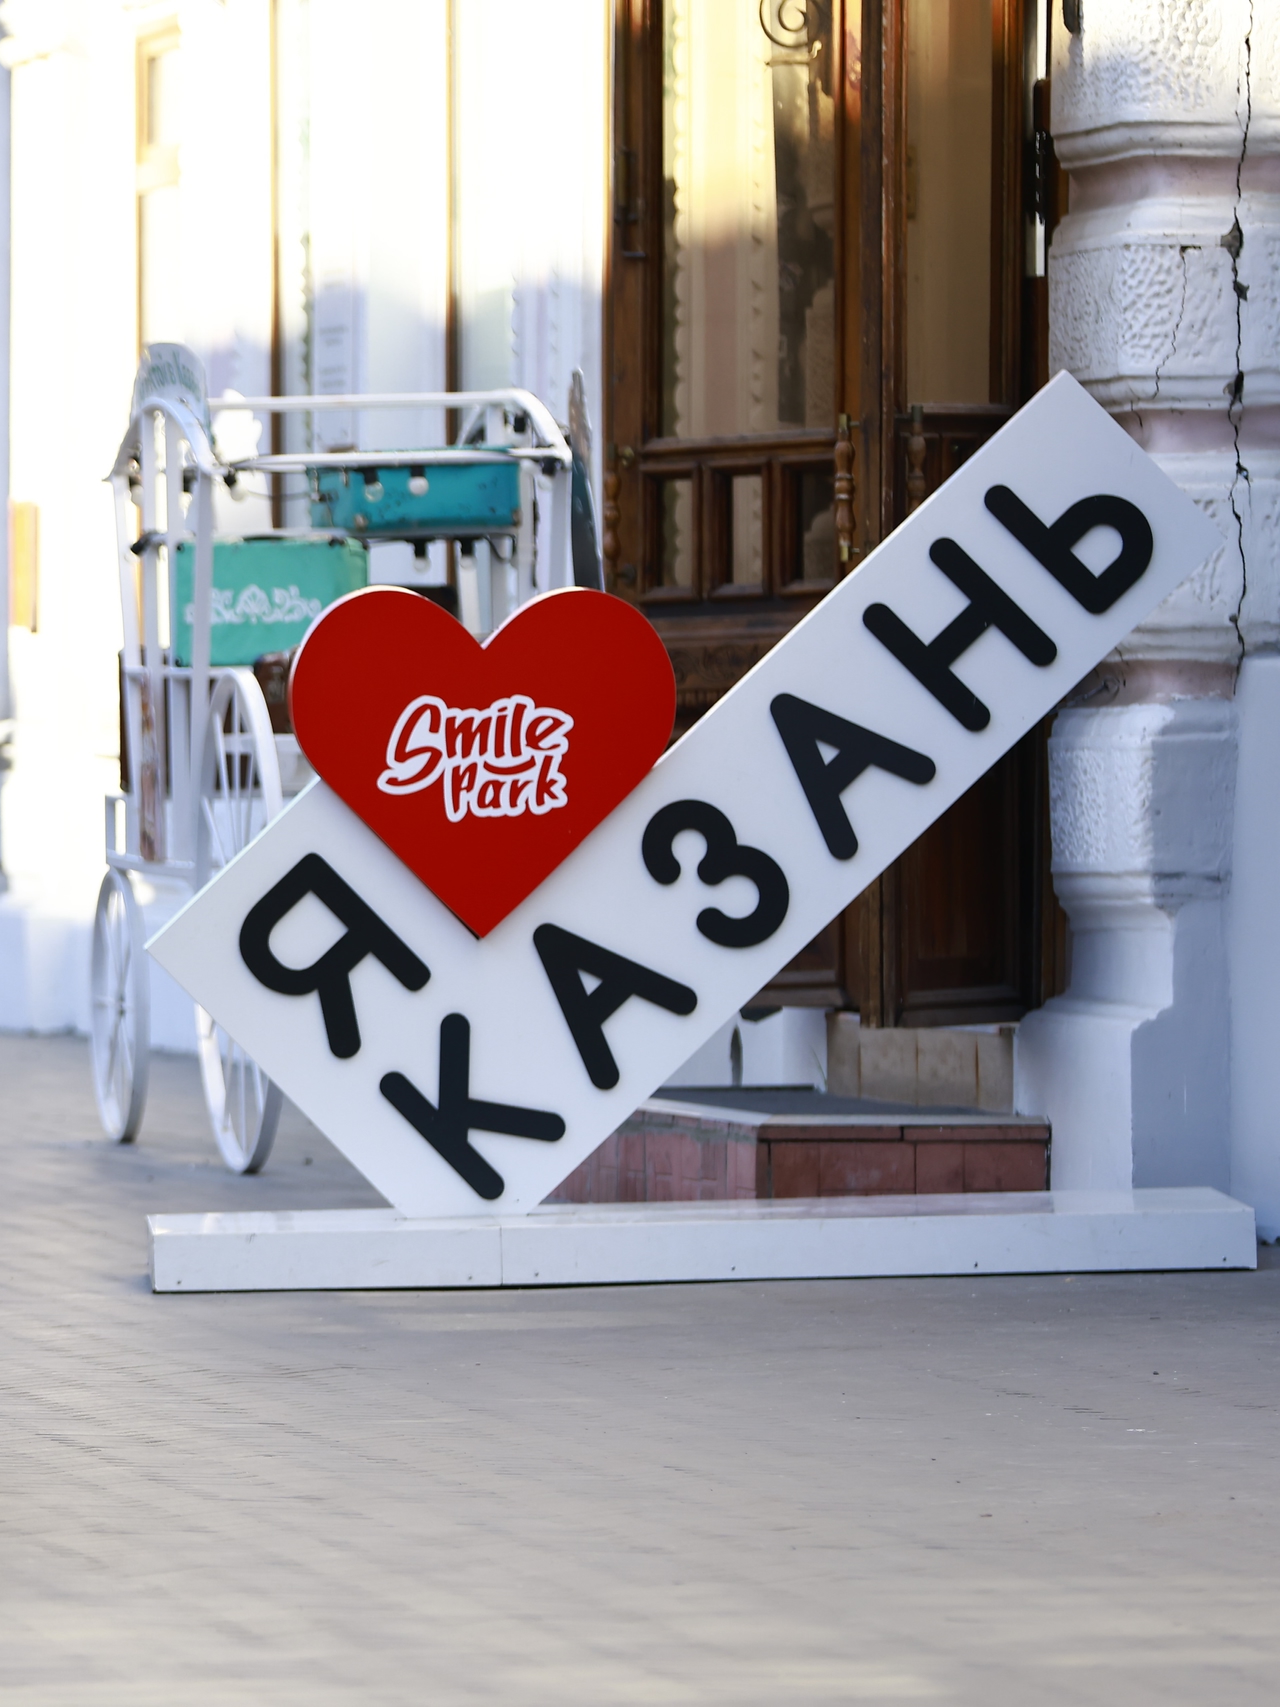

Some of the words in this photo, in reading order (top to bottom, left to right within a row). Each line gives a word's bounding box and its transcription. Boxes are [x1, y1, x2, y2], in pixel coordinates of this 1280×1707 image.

[380, 697, 570, 791] Smile
[447, 753, 565, 819] Park
[379, 484, 1154, 1200] КАЗАНЬ
[239, 852, 431, 1059] Я
